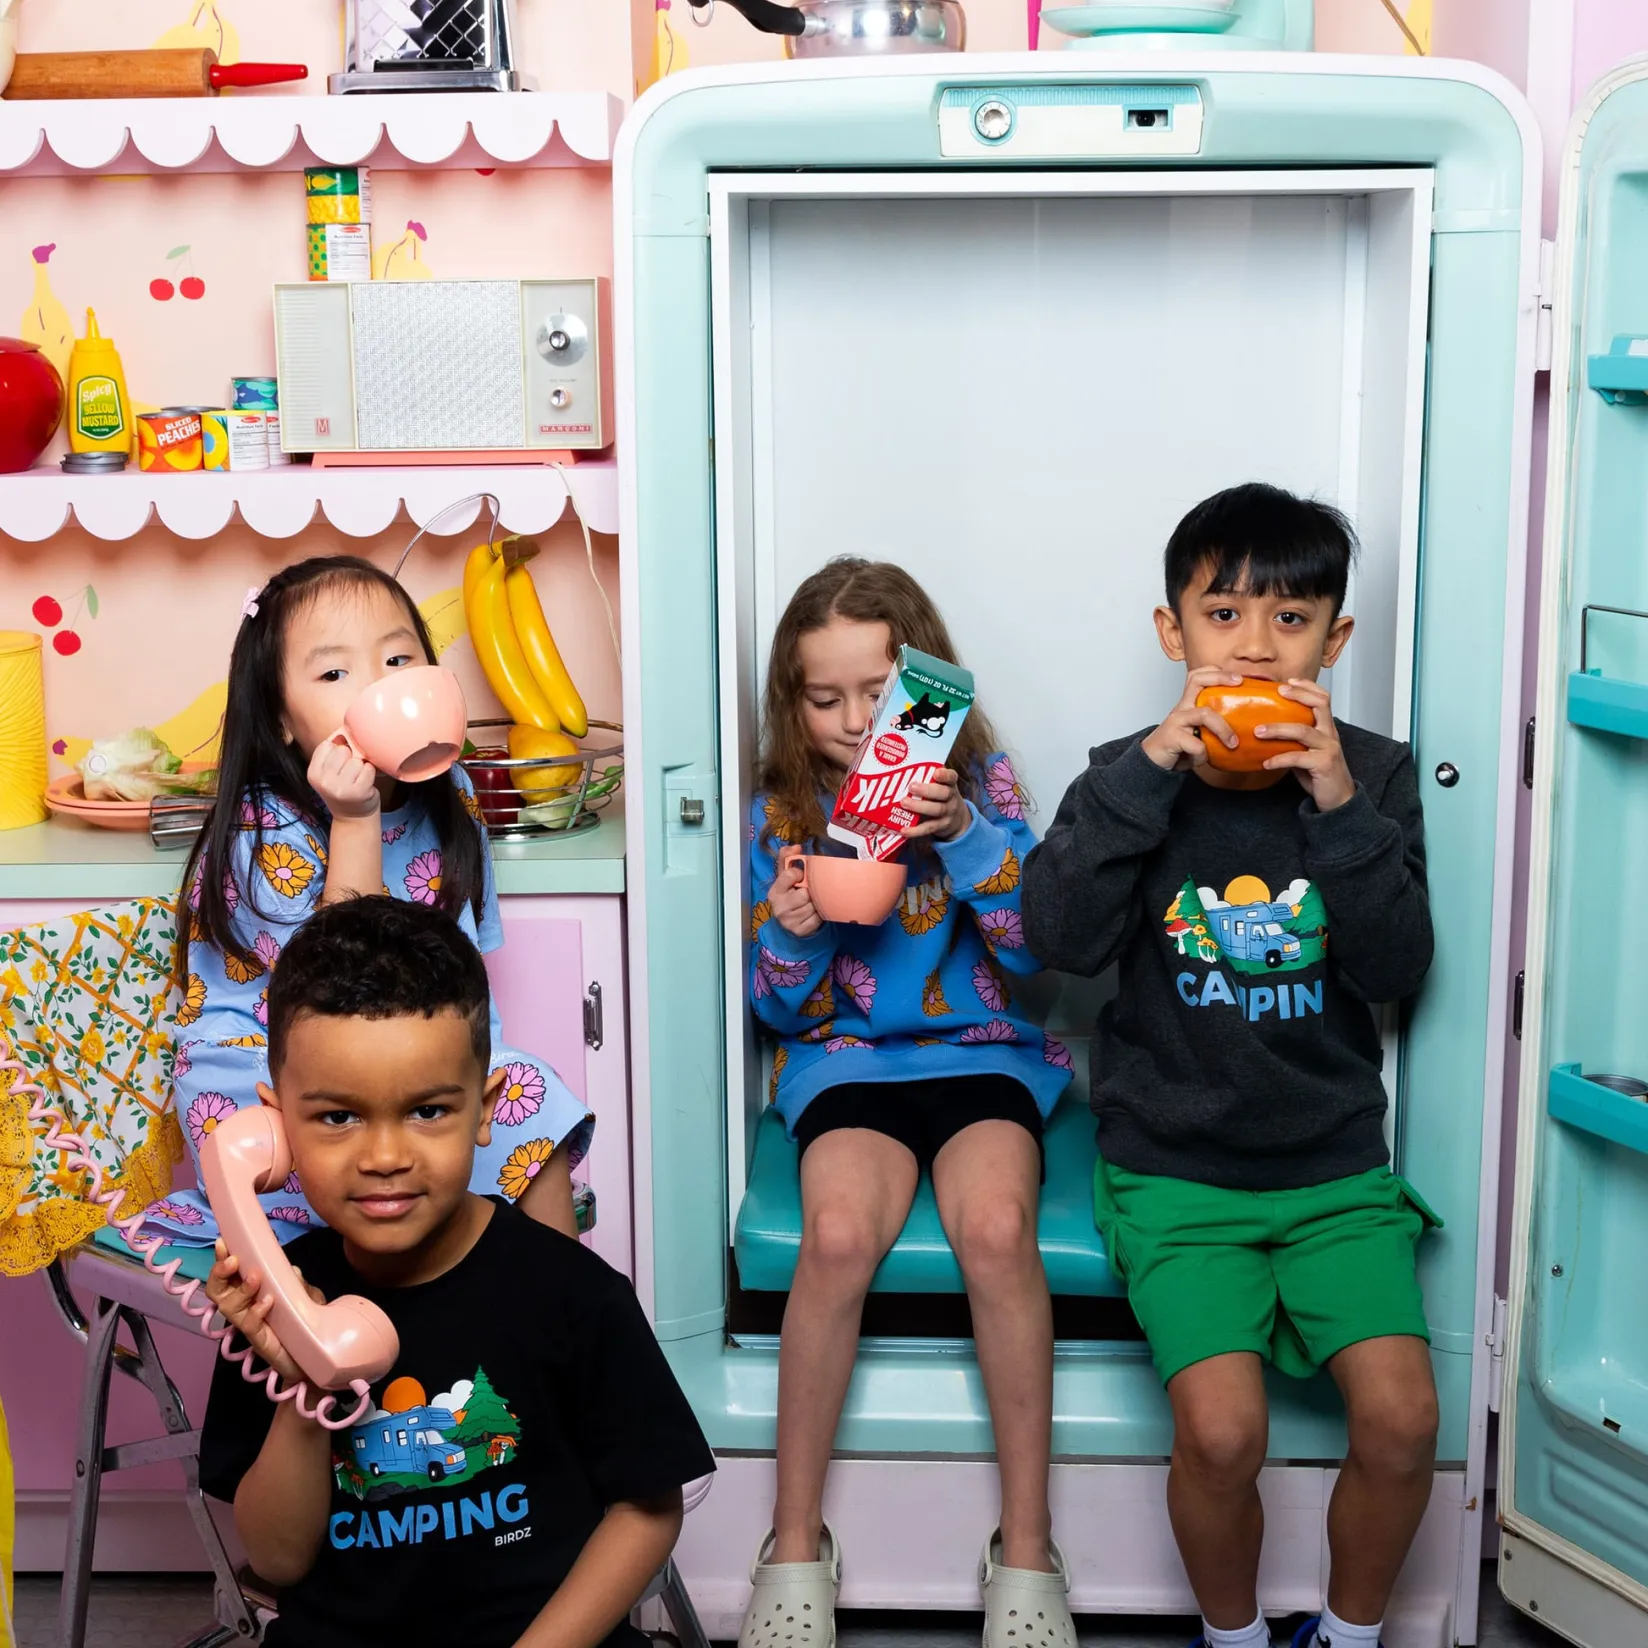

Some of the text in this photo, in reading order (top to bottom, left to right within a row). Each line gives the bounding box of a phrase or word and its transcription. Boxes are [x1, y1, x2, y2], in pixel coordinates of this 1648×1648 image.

[83, 383, 112, 403] Spicy
[84, 403, 115, 415] YELLOW
[82, 414, 119, 427] MUSTARD
[165, 416, 192, 431] SLICED
[157, 420, 201, 446] PEACHES
[933, 680, 942, 689] OZ
[941, 683, 949, 692] FL
[948, 686, 957, 695] 32
[851, 766, 936, 813] Milk
[891, 806, 915, 820] FRESH
[888, 815, 912, 828] DAIRY
[329, 1483, 530, 1550] CAMPING
[494, 1527, 532, 1547] BIRDZ
